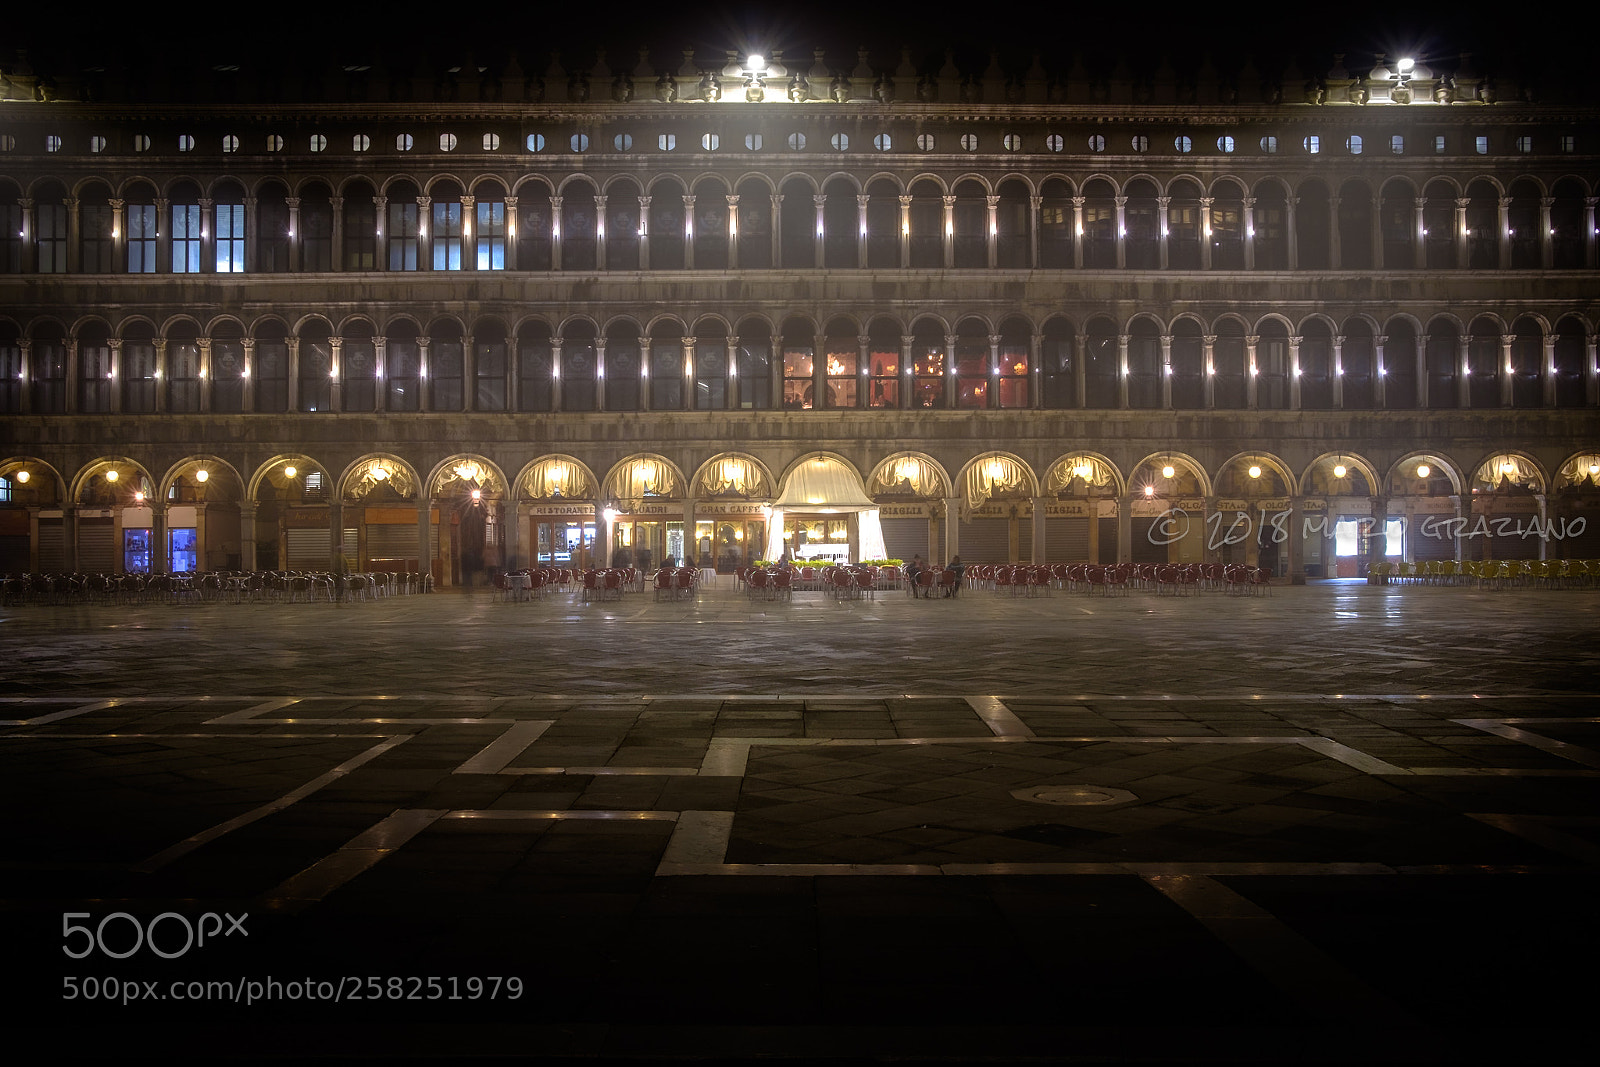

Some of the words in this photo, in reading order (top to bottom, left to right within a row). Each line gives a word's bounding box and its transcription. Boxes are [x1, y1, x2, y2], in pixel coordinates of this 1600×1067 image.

[536, 506, 596, 514] RISTORANTE
[1179, 502, 1202, 510] OLG
[879, 506, 923, 515] SIAGLIA
